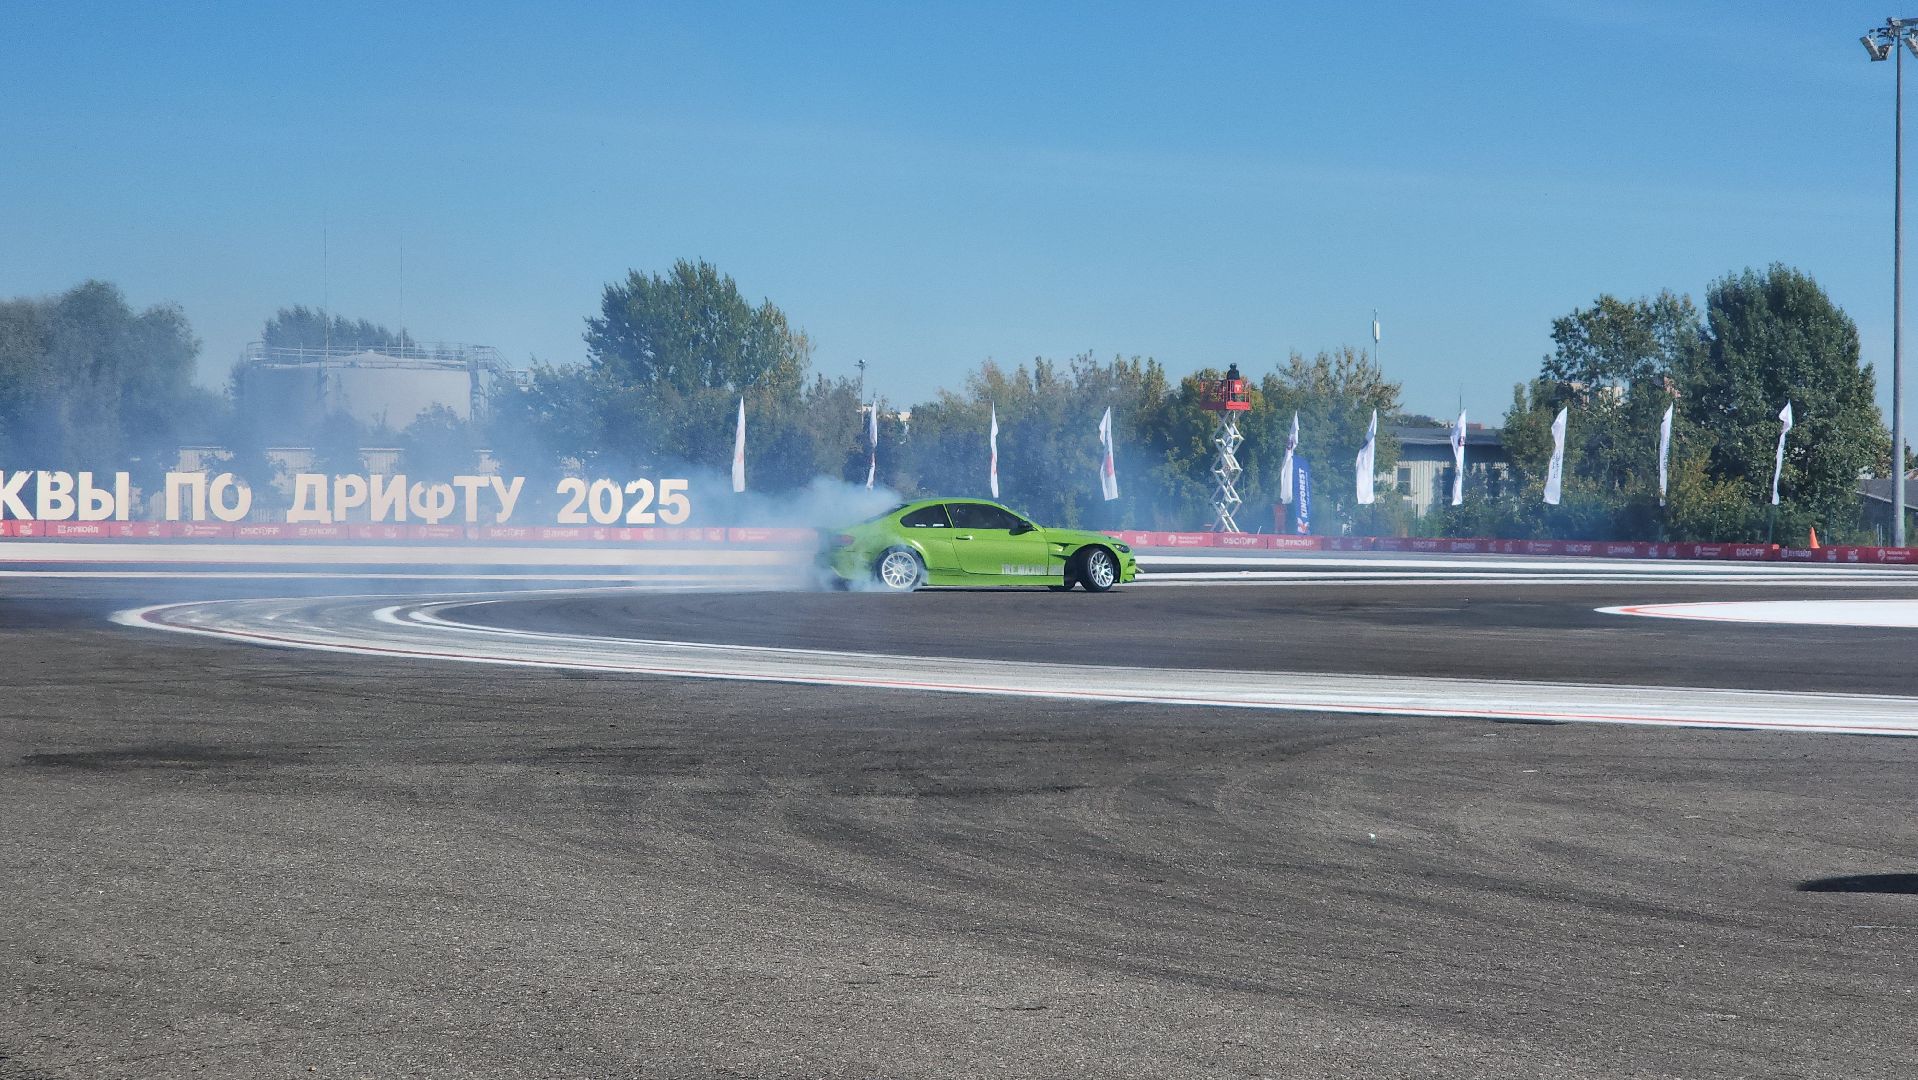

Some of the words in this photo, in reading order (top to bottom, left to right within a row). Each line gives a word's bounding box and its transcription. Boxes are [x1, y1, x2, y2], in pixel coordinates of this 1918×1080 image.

[0, 471, 129, 520] КВЫ
[166, 472, 252, 521] ПО
[287, 473, 526, 524] ДРИФТУ
[556, 477, 691, 524] 2025
